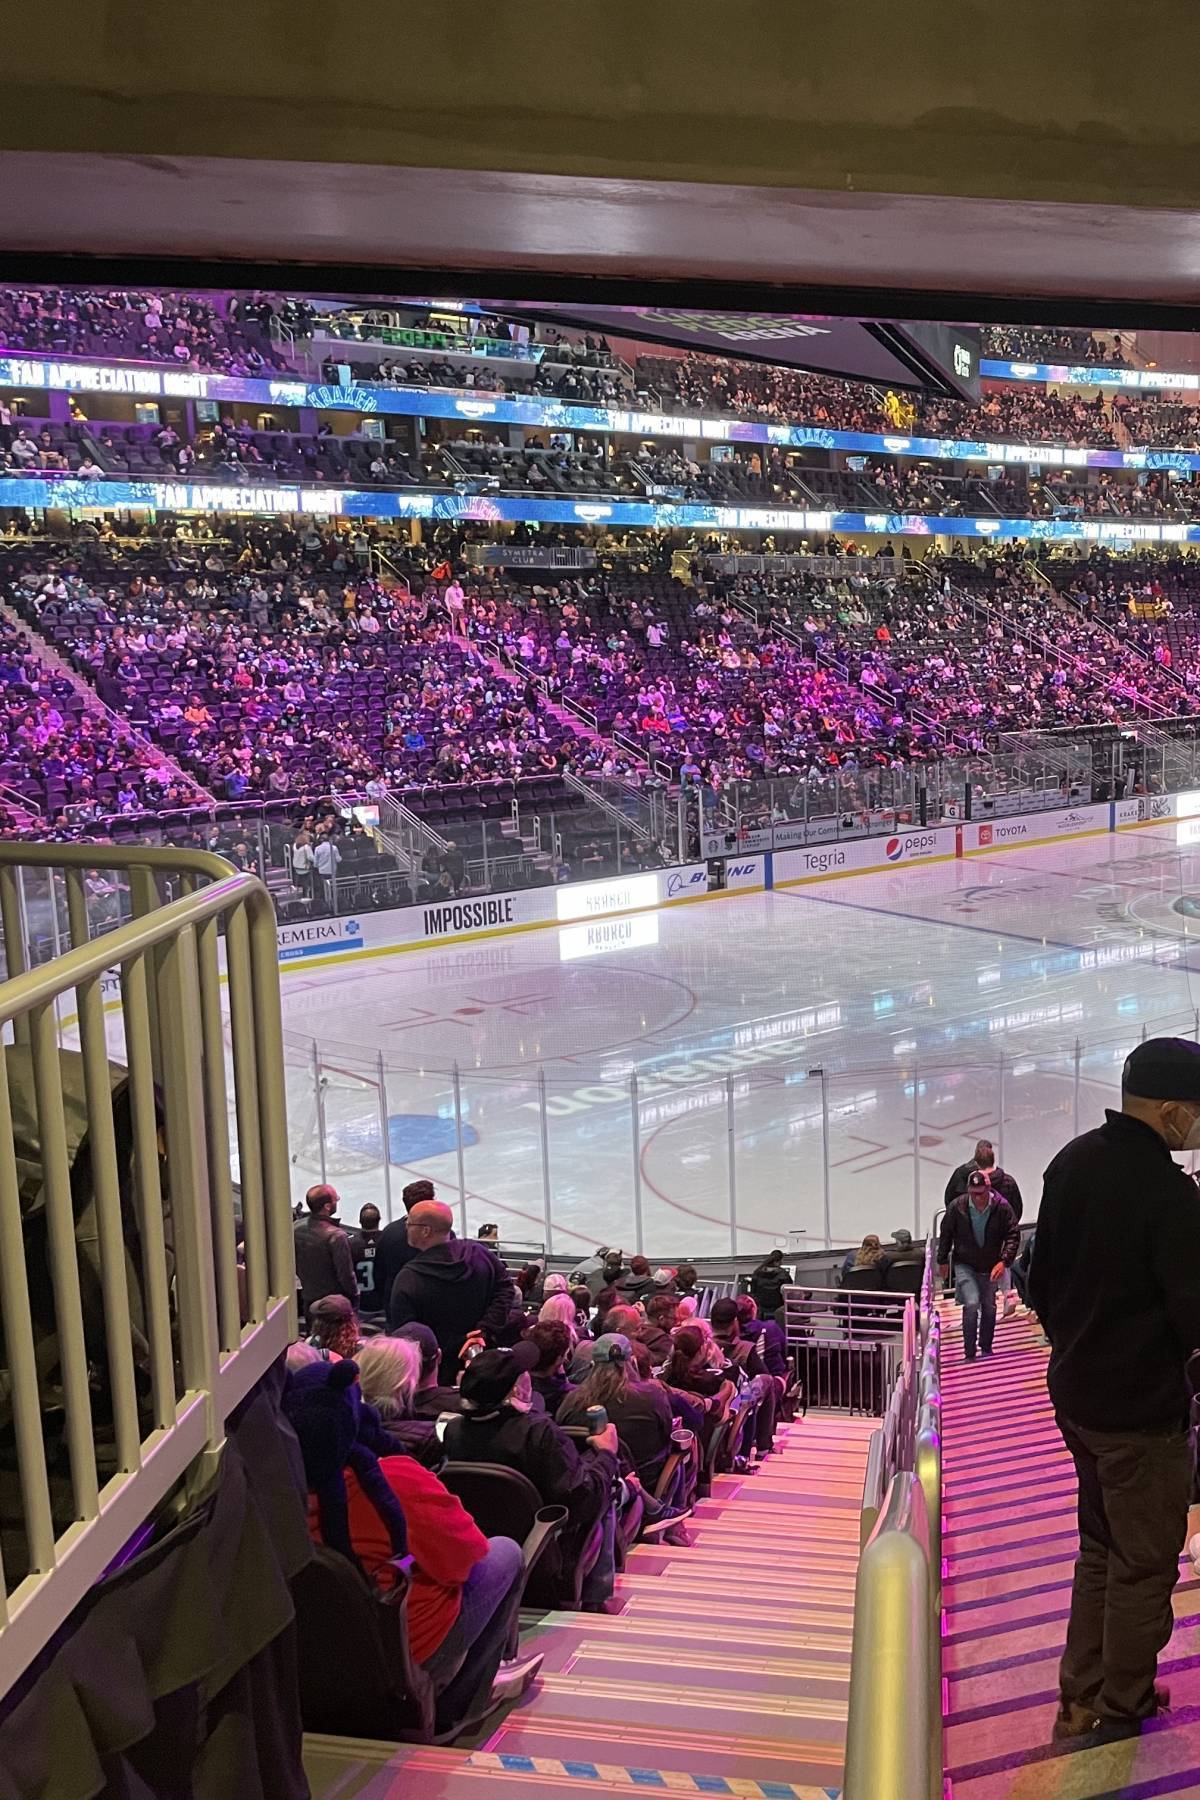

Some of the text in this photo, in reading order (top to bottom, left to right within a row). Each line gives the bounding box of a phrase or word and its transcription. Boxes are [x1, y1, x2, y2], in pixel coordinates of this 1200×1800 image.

[717, 325, 833, 342] ARENA
[11, 360, 45, 386] FAN
[51, 364, 161, 393] APPRECIATION
[307, 386, 377, 412] KRAKEN
[156, 483, 188, 509] FAN
[191, 486, 299, 512] APPRECIATION
[434, 497, 502, 520] KRAKEN
[503, 549, 544, 557] SYMETRA
[512, 557, 535, 565] CLUB
[949, 808, 956, 816] G
[776, 831, 802, 842] Making
[804, 829, 817, 838] Our
[995, 825, 1028, 837] TOYOTA
[905, 832, 937, 852] pepsi
[804, 850, 846, 872] Tegria
[424, 898, 514, 935] IMPOSSIBLE
